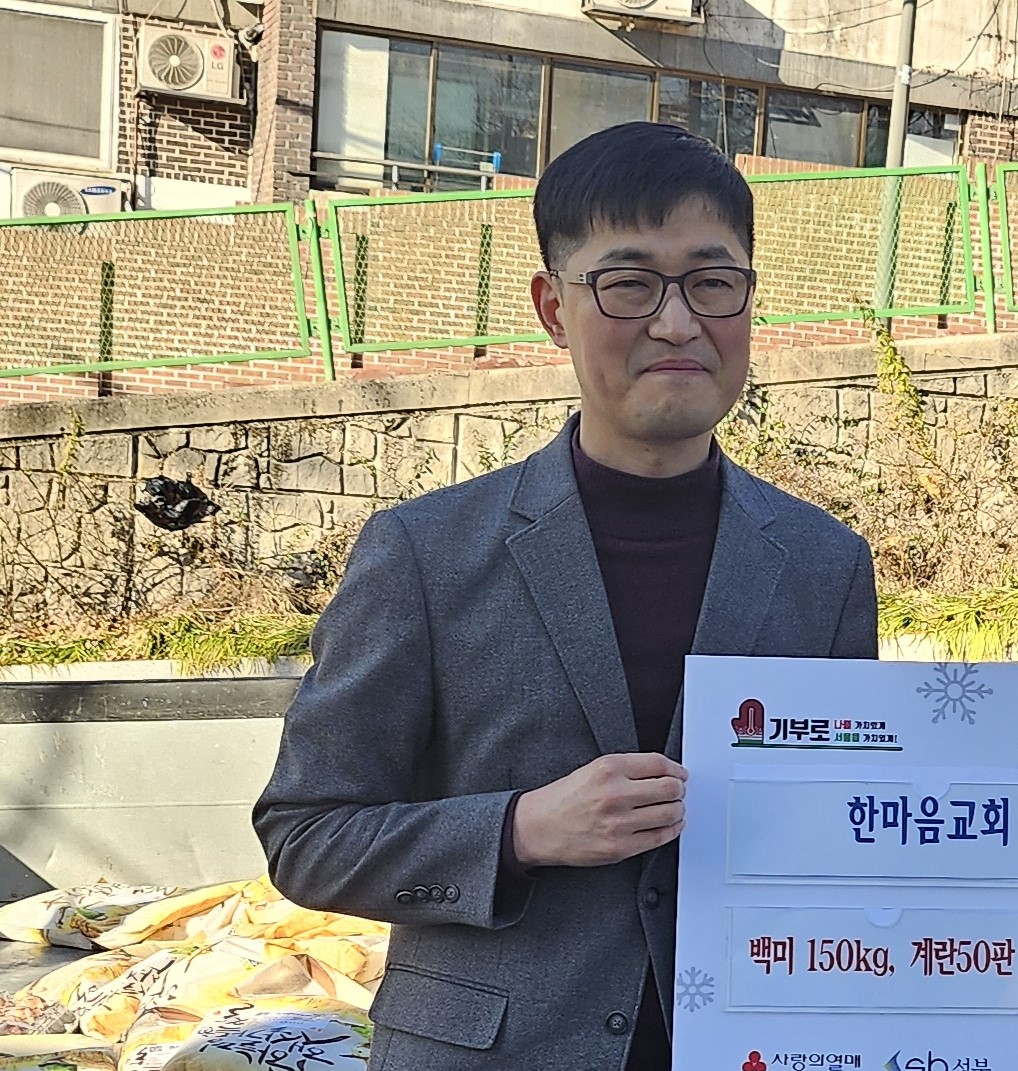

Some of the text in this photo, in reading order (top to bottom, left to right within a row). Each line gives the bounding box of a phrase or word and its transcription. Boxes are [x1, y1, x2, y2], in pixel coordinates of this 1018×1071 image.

[211, 61, 224, 71] LG
[768, 718, 831, 742] 기부로
[847, 795, 1009, 846] 한마음교회
[749, 936, 1016, 977] 백미 150kg, 계란50판
